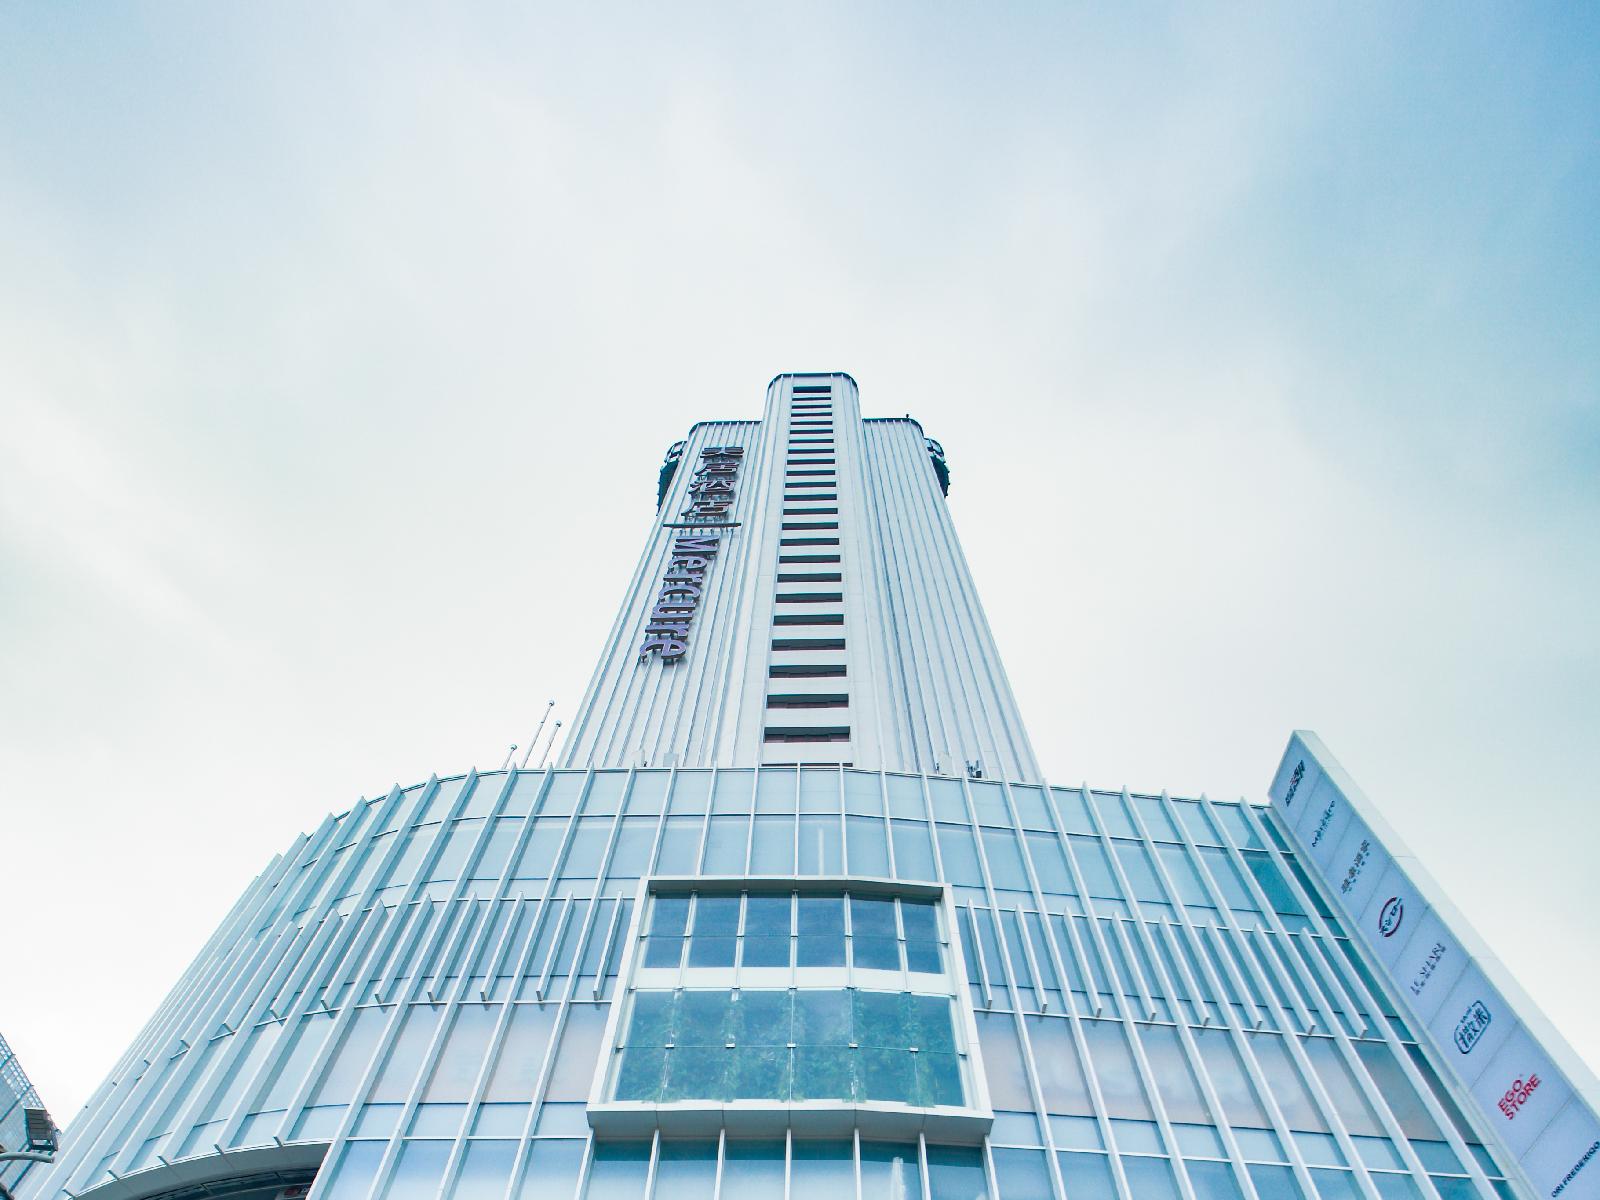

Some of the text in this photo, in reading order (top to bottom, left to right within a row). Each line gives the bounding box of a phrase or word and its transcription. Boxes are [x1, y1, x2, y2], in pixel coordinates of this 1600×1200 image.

[681, 446, 745, 517] 美居酒店
[639, 535, 721, 662] Mercure
[1498, 1079, 1522, 1112] EGO
[1505, 1073, 1541, 1120] STORE
